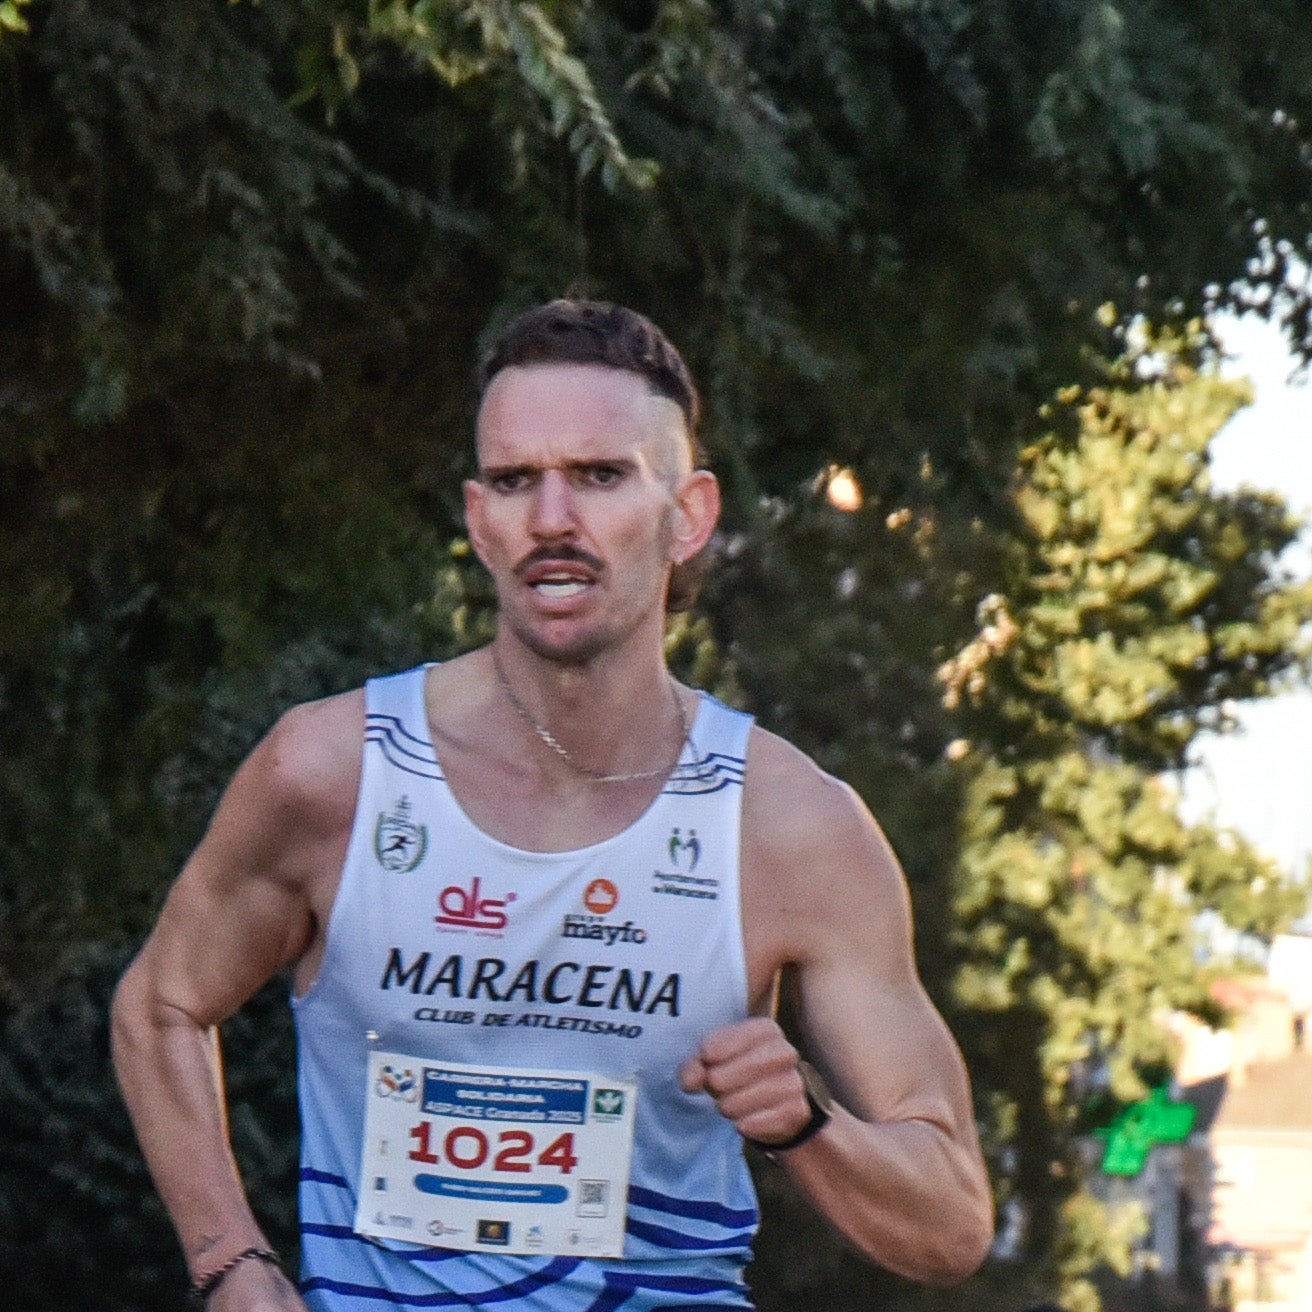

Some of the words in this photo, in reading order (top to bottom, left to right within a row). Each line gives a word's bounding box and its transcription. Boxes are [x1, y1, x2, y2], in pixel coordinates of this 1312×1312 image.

[381, 947, 680, 1018] MARACENA
[414, 1007, 475, 1024] CLUB
[481, 1012, 512, 1027] DE
[515, 1013, 643, 1039] ATLETISMO
[408, 1121, 578, 1175] 1024
